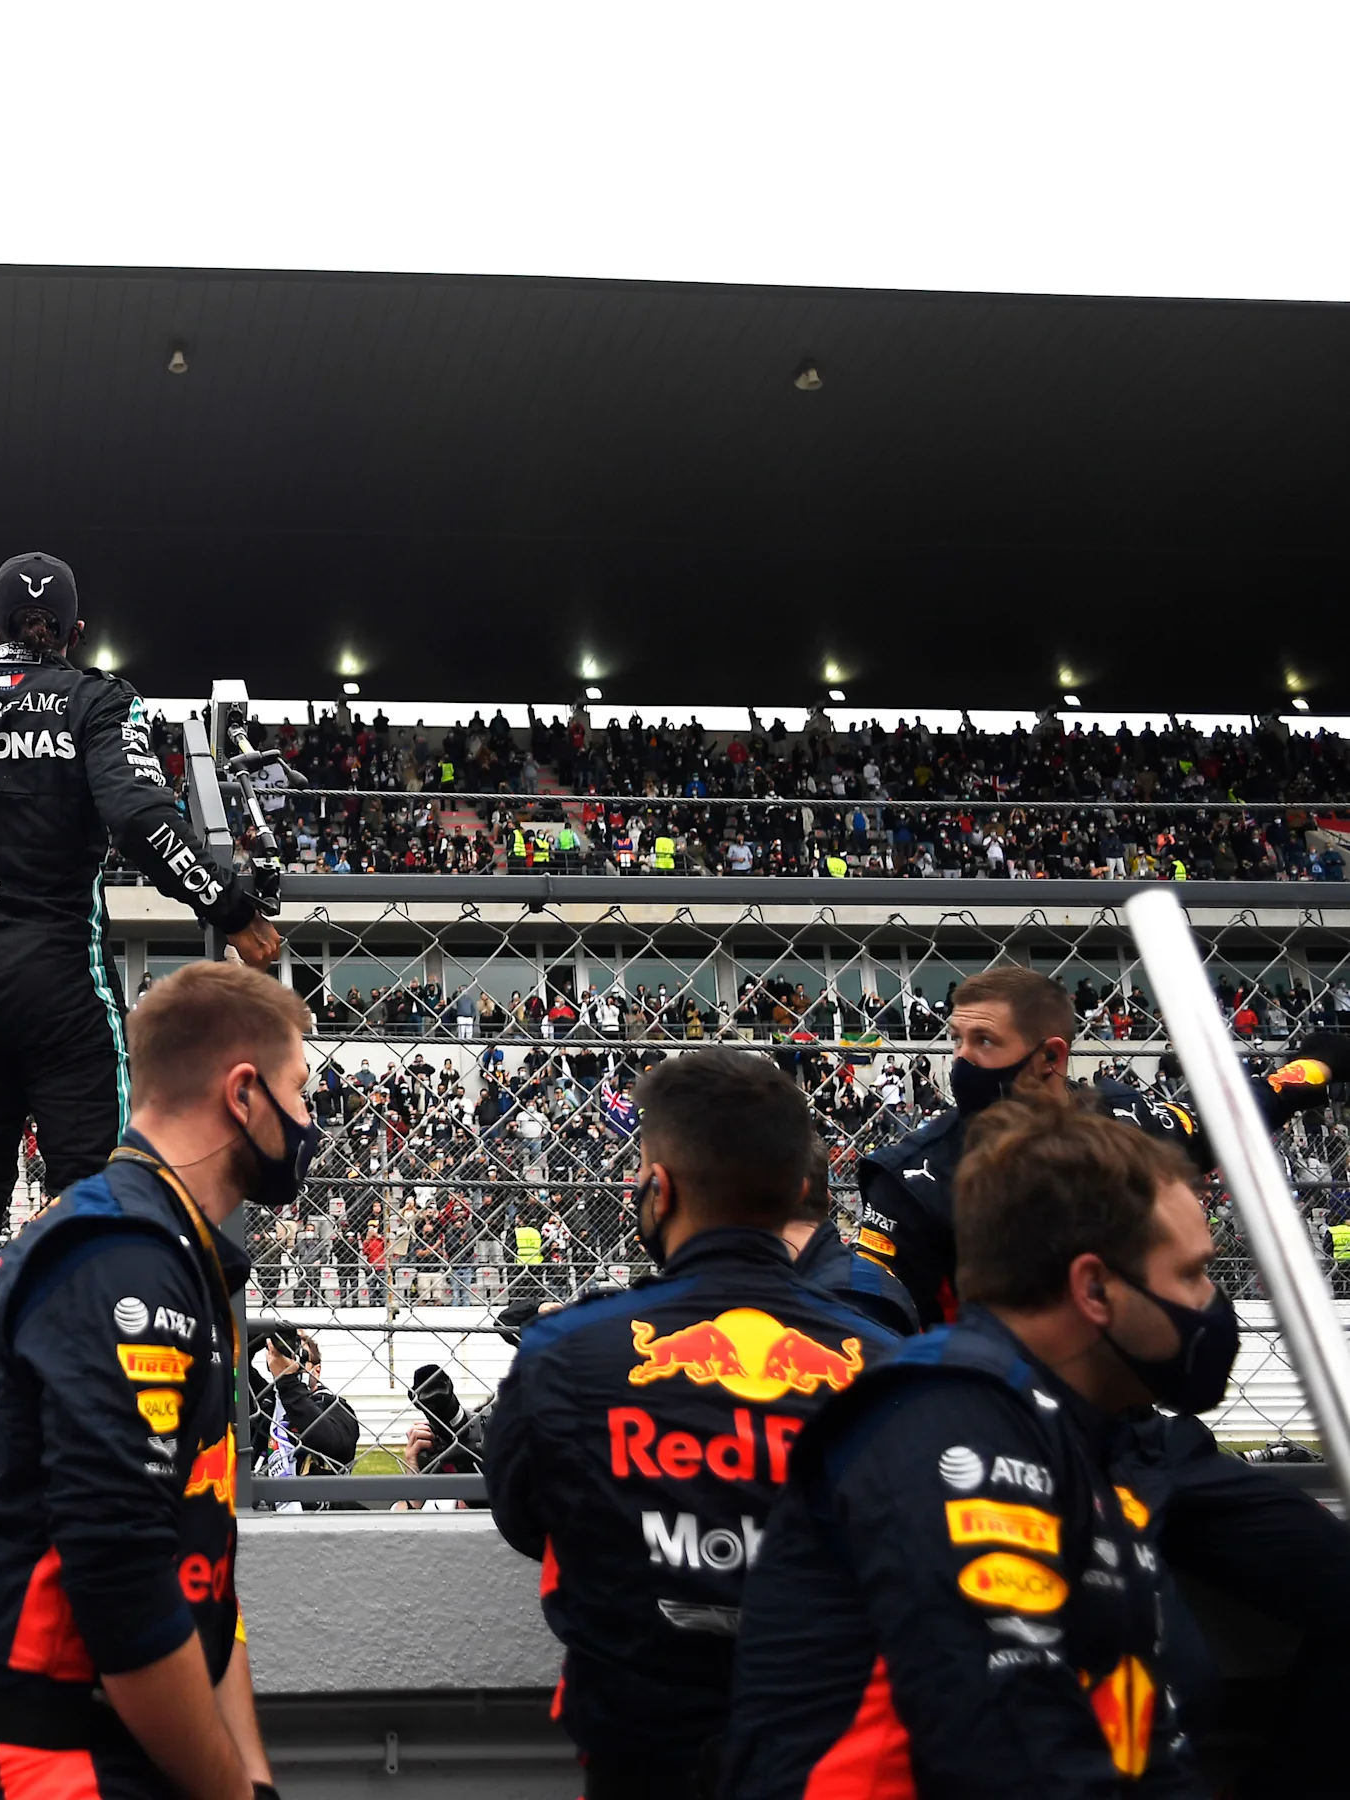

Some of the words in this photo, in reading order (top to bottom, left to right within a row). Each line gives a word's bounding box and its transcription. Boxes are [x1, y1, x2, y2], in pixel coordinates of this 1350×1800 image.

[146, 821, 224, 905] INEOS
[869, 1210, 898, 1232] AT&T
[607, 1406, 753, 1480] Red
